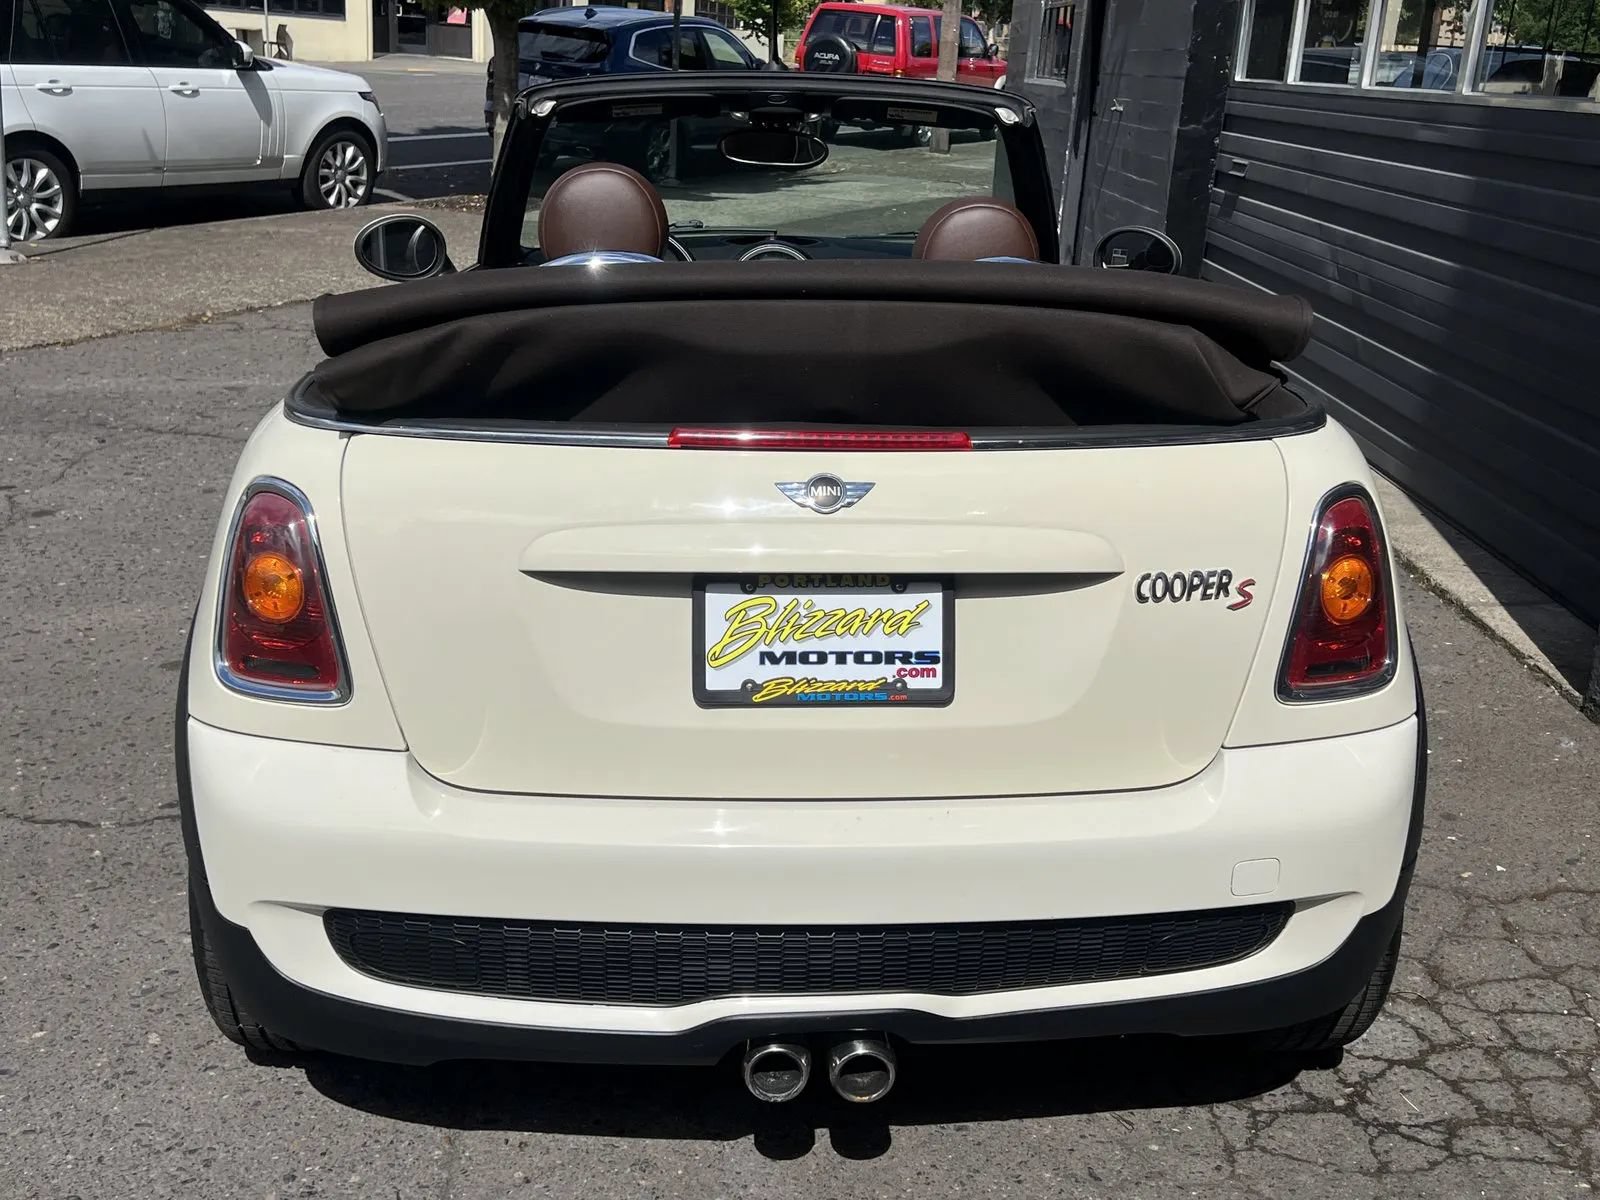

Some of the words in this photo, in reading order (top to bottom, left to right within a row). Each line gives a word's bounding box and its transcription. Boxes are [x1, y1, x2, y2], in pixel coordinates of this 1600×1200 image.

[813, 52, 840, 60] ACURA
[810, 486, 841, 497] MINI
[758, 574, 892, 588] PORTLAND
[1135, 569, 1233, 604] COOPER
[1226, 578, 1256, 611] S
[707, 596, 930, 668] Blizzard
[759, 650, 941, 665] MOTORS
[892, 666, 937, 678] .com
[752, 677, 887, 703] Blizzard
